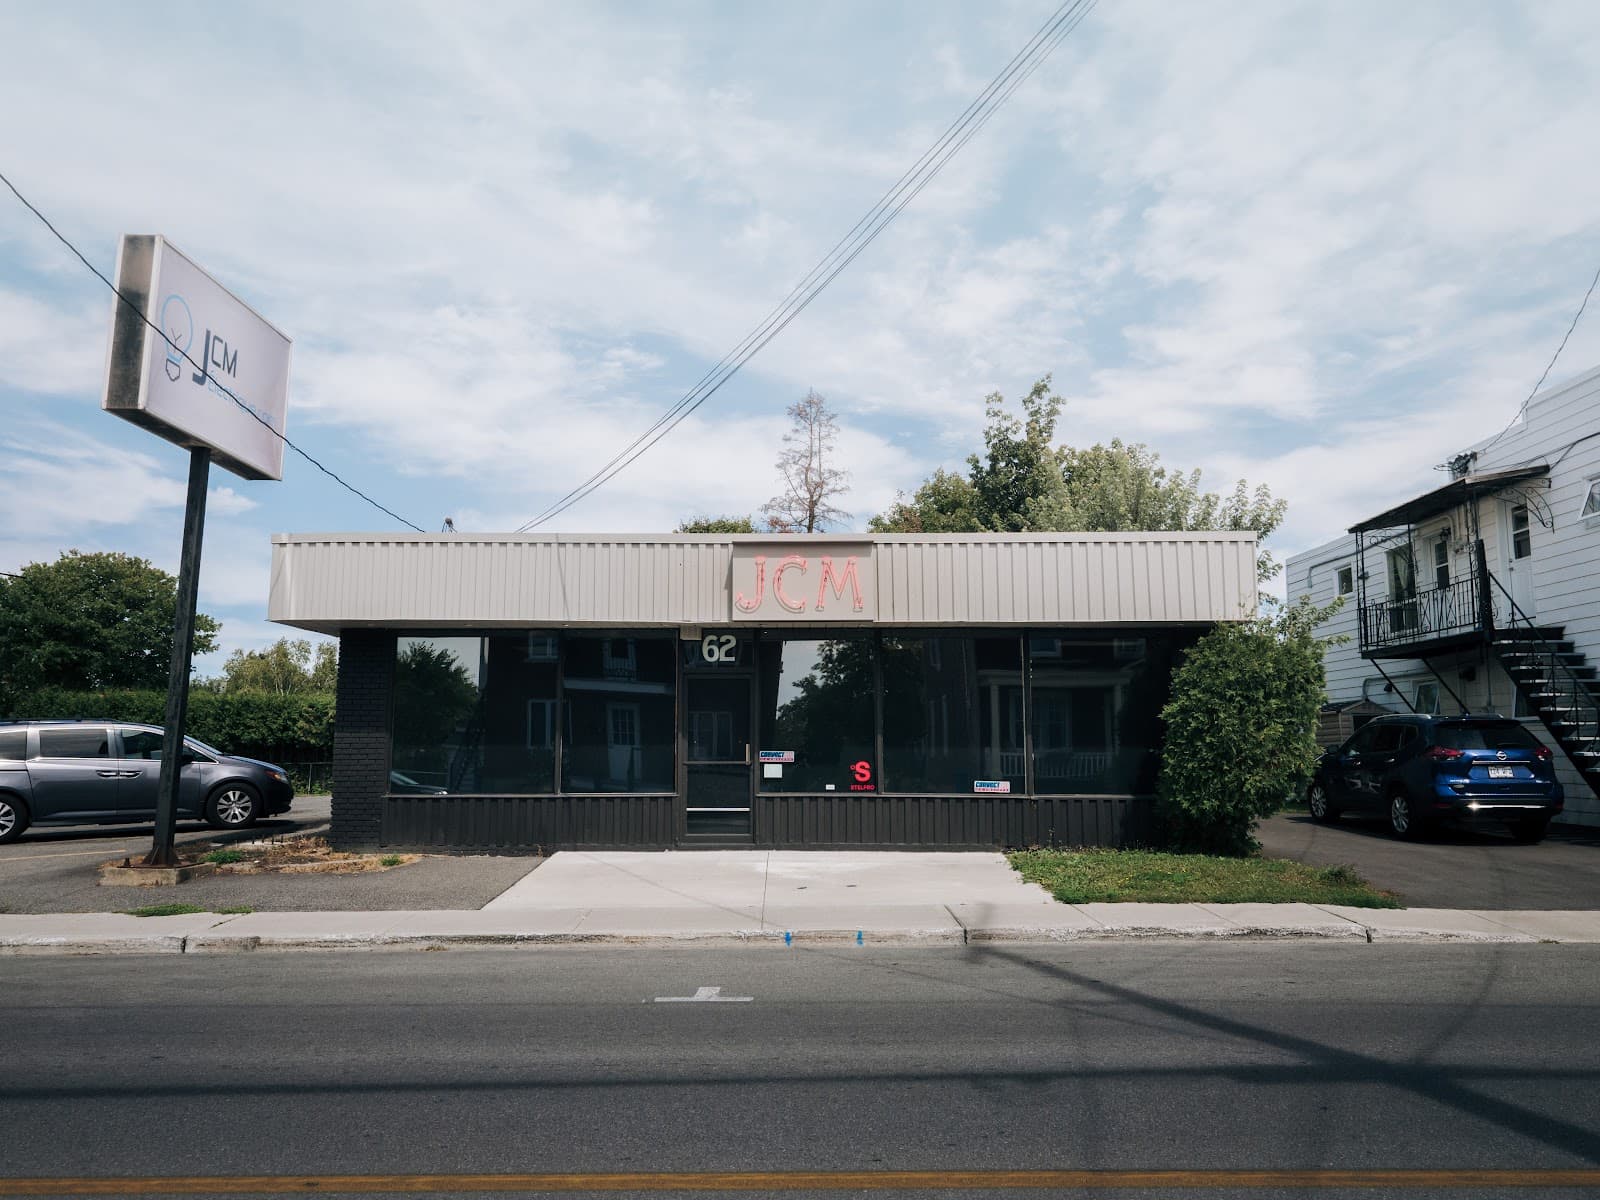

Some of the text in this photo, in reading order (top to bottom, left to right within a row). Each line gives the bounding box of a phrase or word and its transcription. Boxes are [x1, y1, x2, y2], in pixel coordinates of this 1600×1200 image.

[192, 328, 238, 386] JCM
[736, 554, 863, 613] JCM
[702, 634, 737, 662] 62
